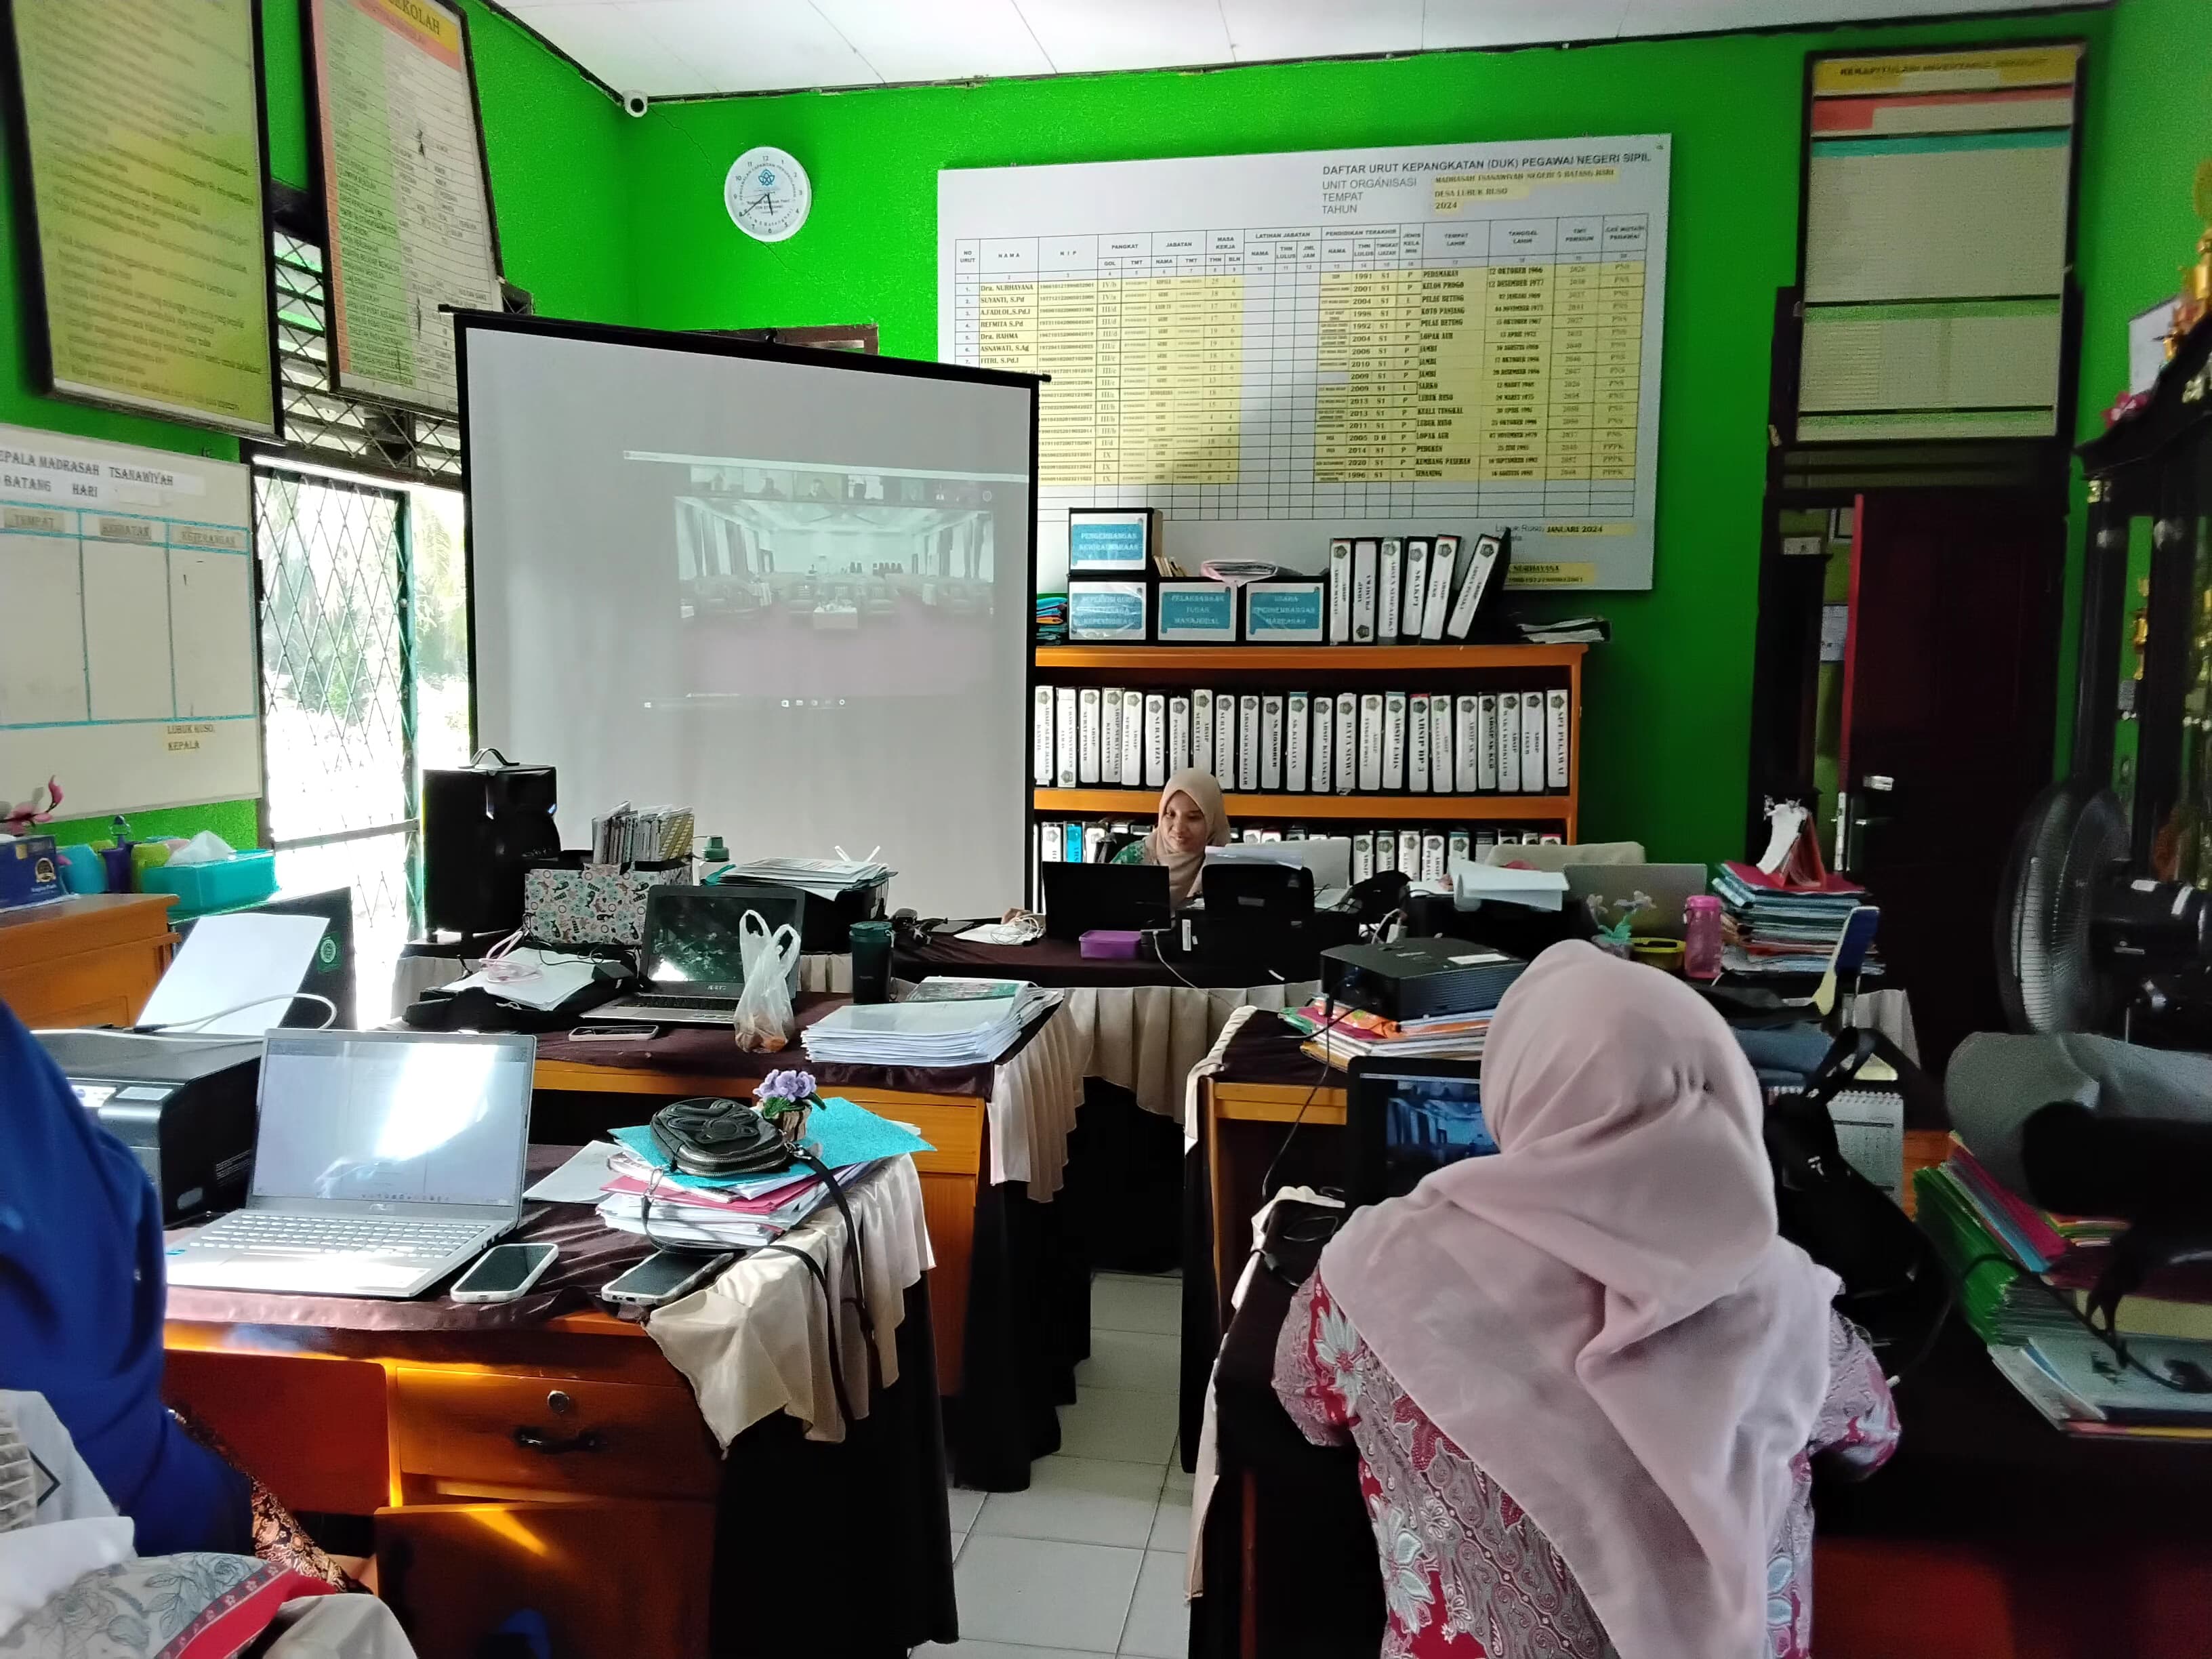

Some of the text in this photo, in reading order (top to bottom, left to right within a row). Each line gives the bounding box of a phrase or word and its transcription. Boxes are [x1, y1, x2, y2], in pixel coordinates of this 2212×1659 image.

[389, 0, 440, 35] EKOLAH
[1323, 165, 1366, 175] DAFTAR
[1369, 163, 1399, 173] URUT
[1402, 161, 1484, 172] KEPANGKATAN
[1488, 159, 1519, 169] (DUK)
[1522, 156, 1574, 168] PEGAWAI
[1577, 153, 1620, 164] NEGERI
[1322, 178, 1416, 190] UNIT ORGANISASI
[1323, 192, 1363, 202] TEMPAT
[1322, 204, 1357, 214] TAHUN
[1435, 201, 1457, 209] 2024
[39, 456, 100, 476] MADRASAH
[109, 466, 173, 487] TSANAWIYAH
[4, 474, 98, 497] BATANG HARI
[1273, 719, 1278, 729] SK
[1292, 719, 1298, 729] SK
[168, 741, 201, 751] KEPALA
[1418, 750, 1425, 764] DP
